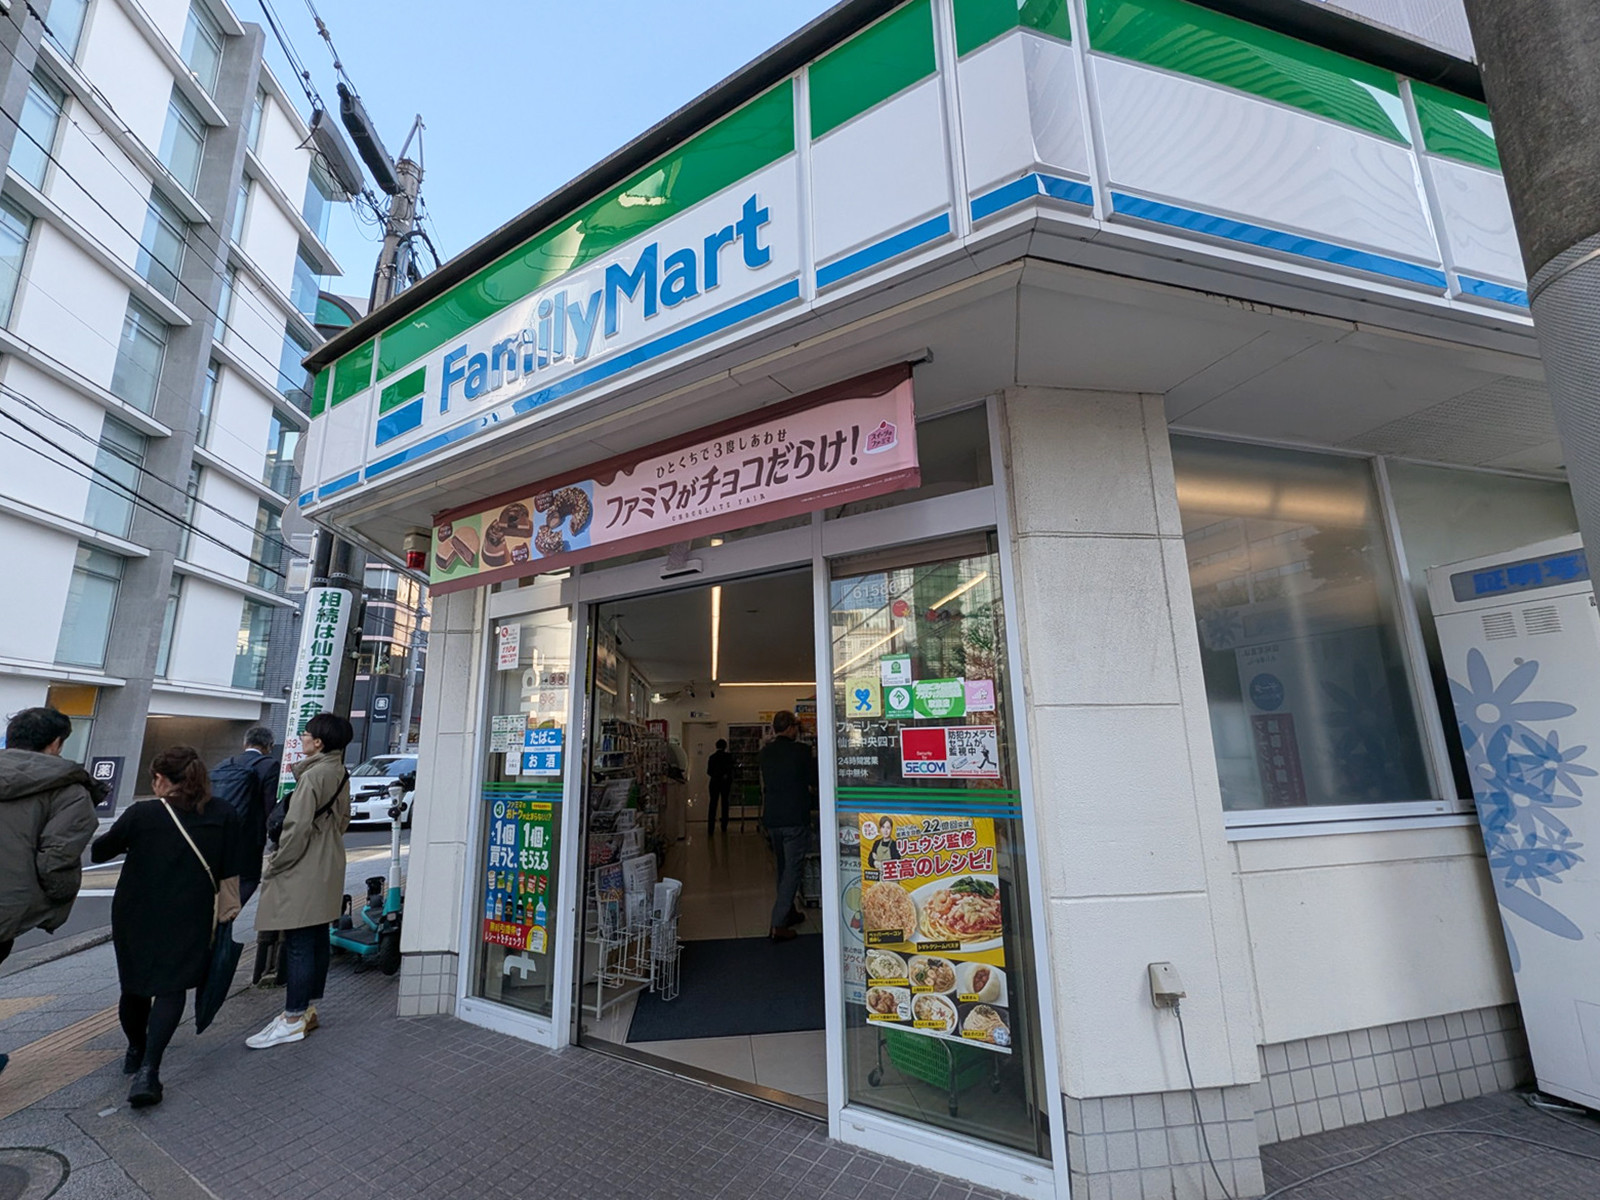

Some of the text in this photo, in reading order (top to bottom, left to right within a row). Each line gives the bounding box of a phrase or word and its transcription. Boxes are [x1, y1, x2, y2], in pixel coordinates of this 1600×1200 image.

[439, 193, 773, 415] FamilyMart
[655, 428, 788, 479] ひとくちで3度しあわせ
[605, 424, 861, 529] ファミマがチョコだらけ!
[671, 493, 766, 522] CHOCOLATE FAIR
[529, 731, 556, 745] たばこ
[836, 720, 906, 733] ファミリーマート
[948, 730, 995, 739] 防犯カメラで
[948, 739, 983, 748] セコムが
[948, 747, 977, 756] 監視中
[837, 756, 879, 766] 24時間営業
[905, 761, 946, 773] SECOM
[838, 768, 869, 778] 年中無休
[495, 820, 516, 846] 1個
[523, 822, 545, 848] 1個
[896, 830, 976, 856] リュウジ監修
[519, 848, 549, 871] もらえる
[882, 847, 994, 881] 至高のレシピ!
